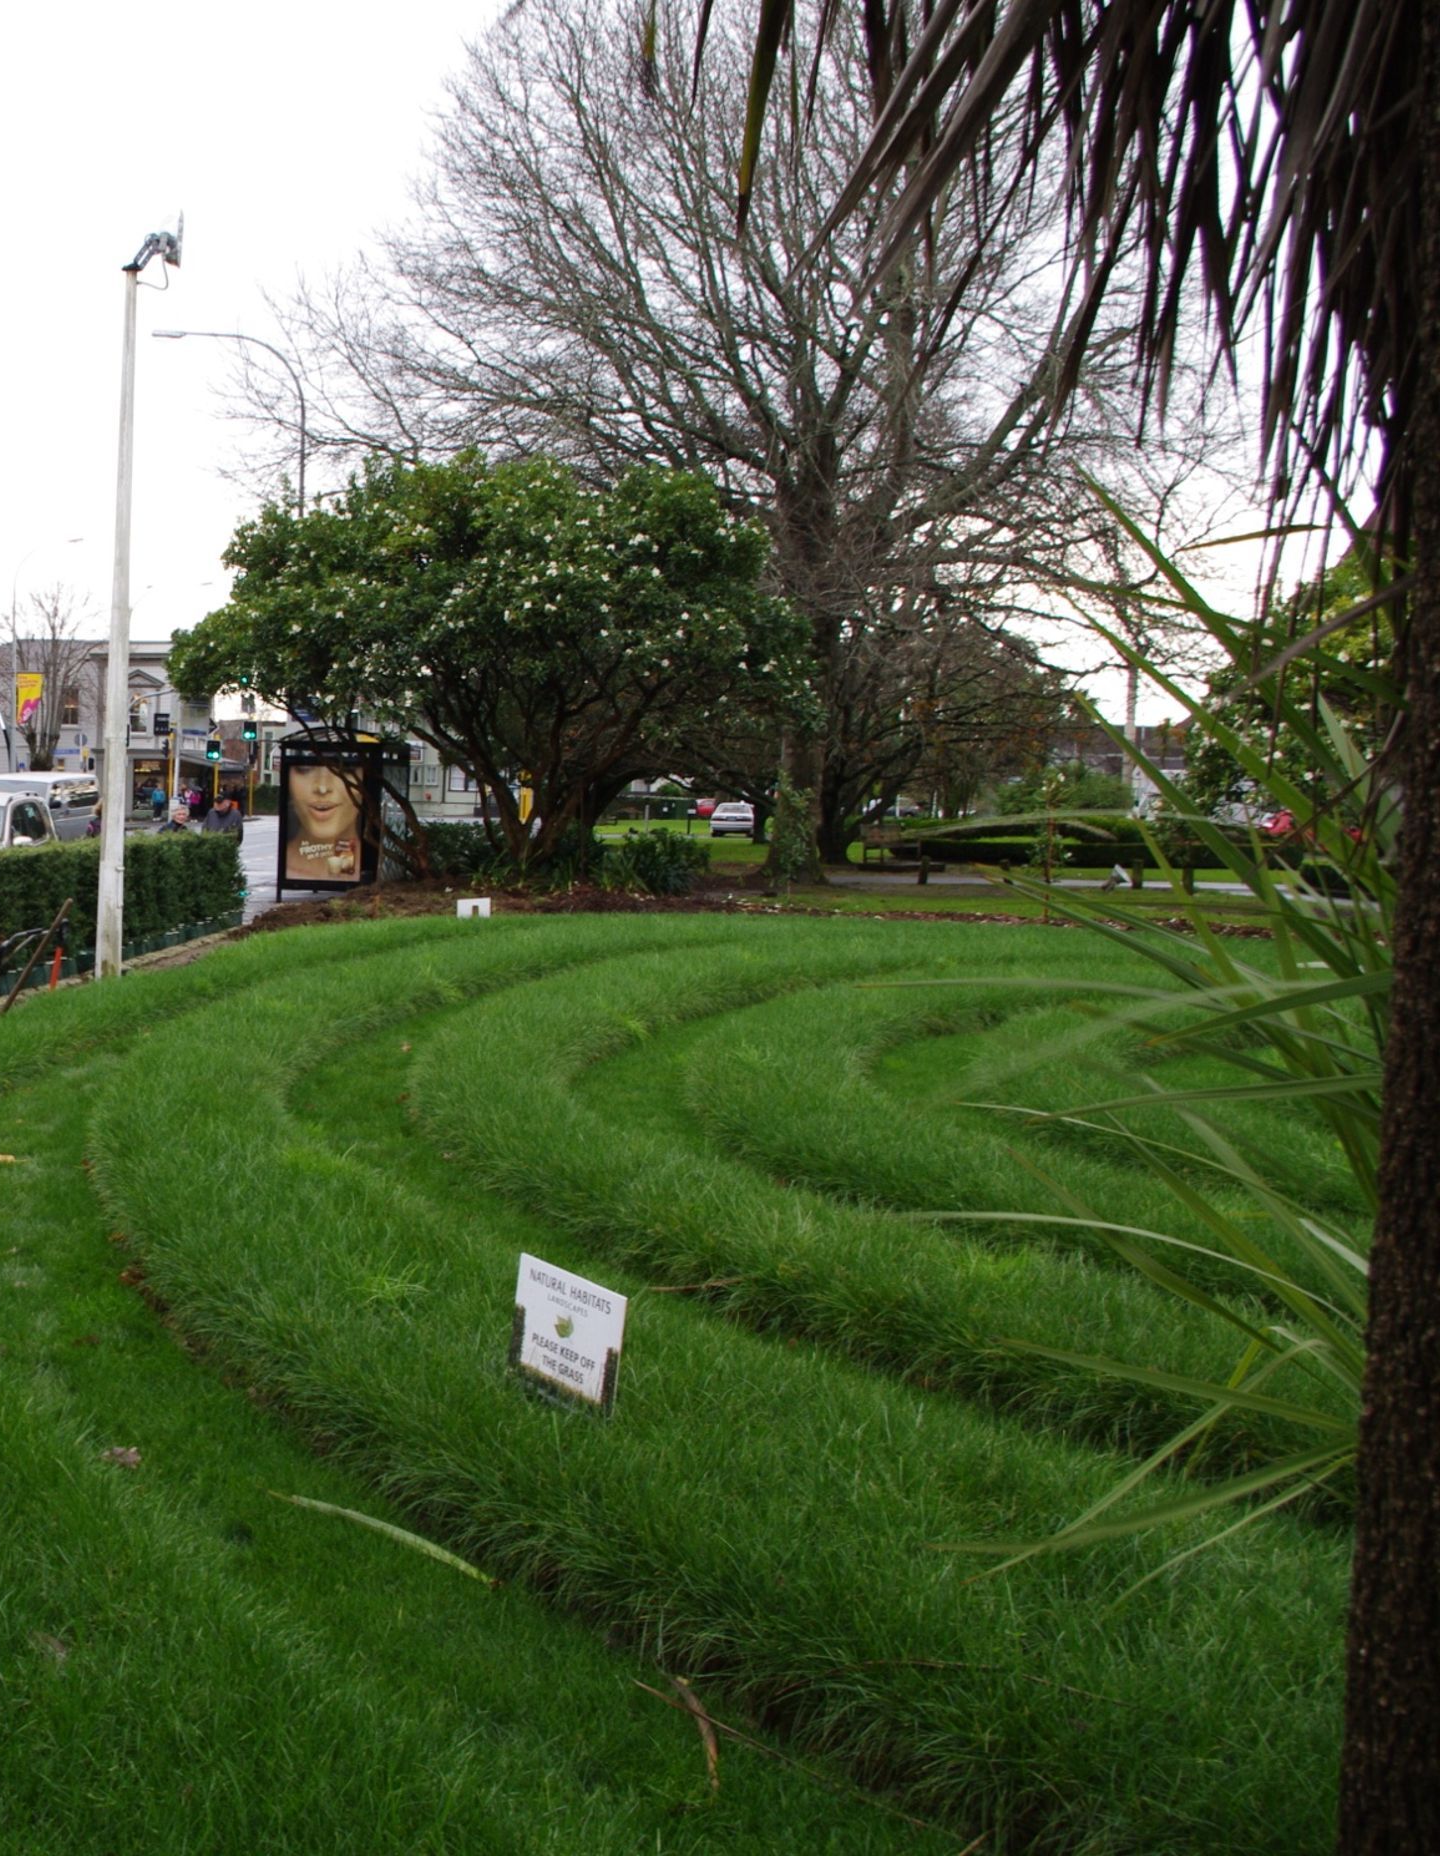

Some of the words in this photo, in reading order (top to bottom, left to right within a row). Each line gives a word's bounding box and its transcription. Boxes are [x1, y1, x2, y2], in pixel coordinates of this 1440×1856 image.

[529, 1268, 568, 1296] NATURAL
[569, 1286, 612, 1315] HABITATS
[547, 1293, 589, 1318] LANDSCAPES
[531, 1333, 559, 1355] PLEASE
[559, 1346, 580, 1363] KEEP
[580, 1355, 596, 1370] OFF
[542, 1355, 556, 1371] THE
[559, 1363, 584, 1385] GRASS
